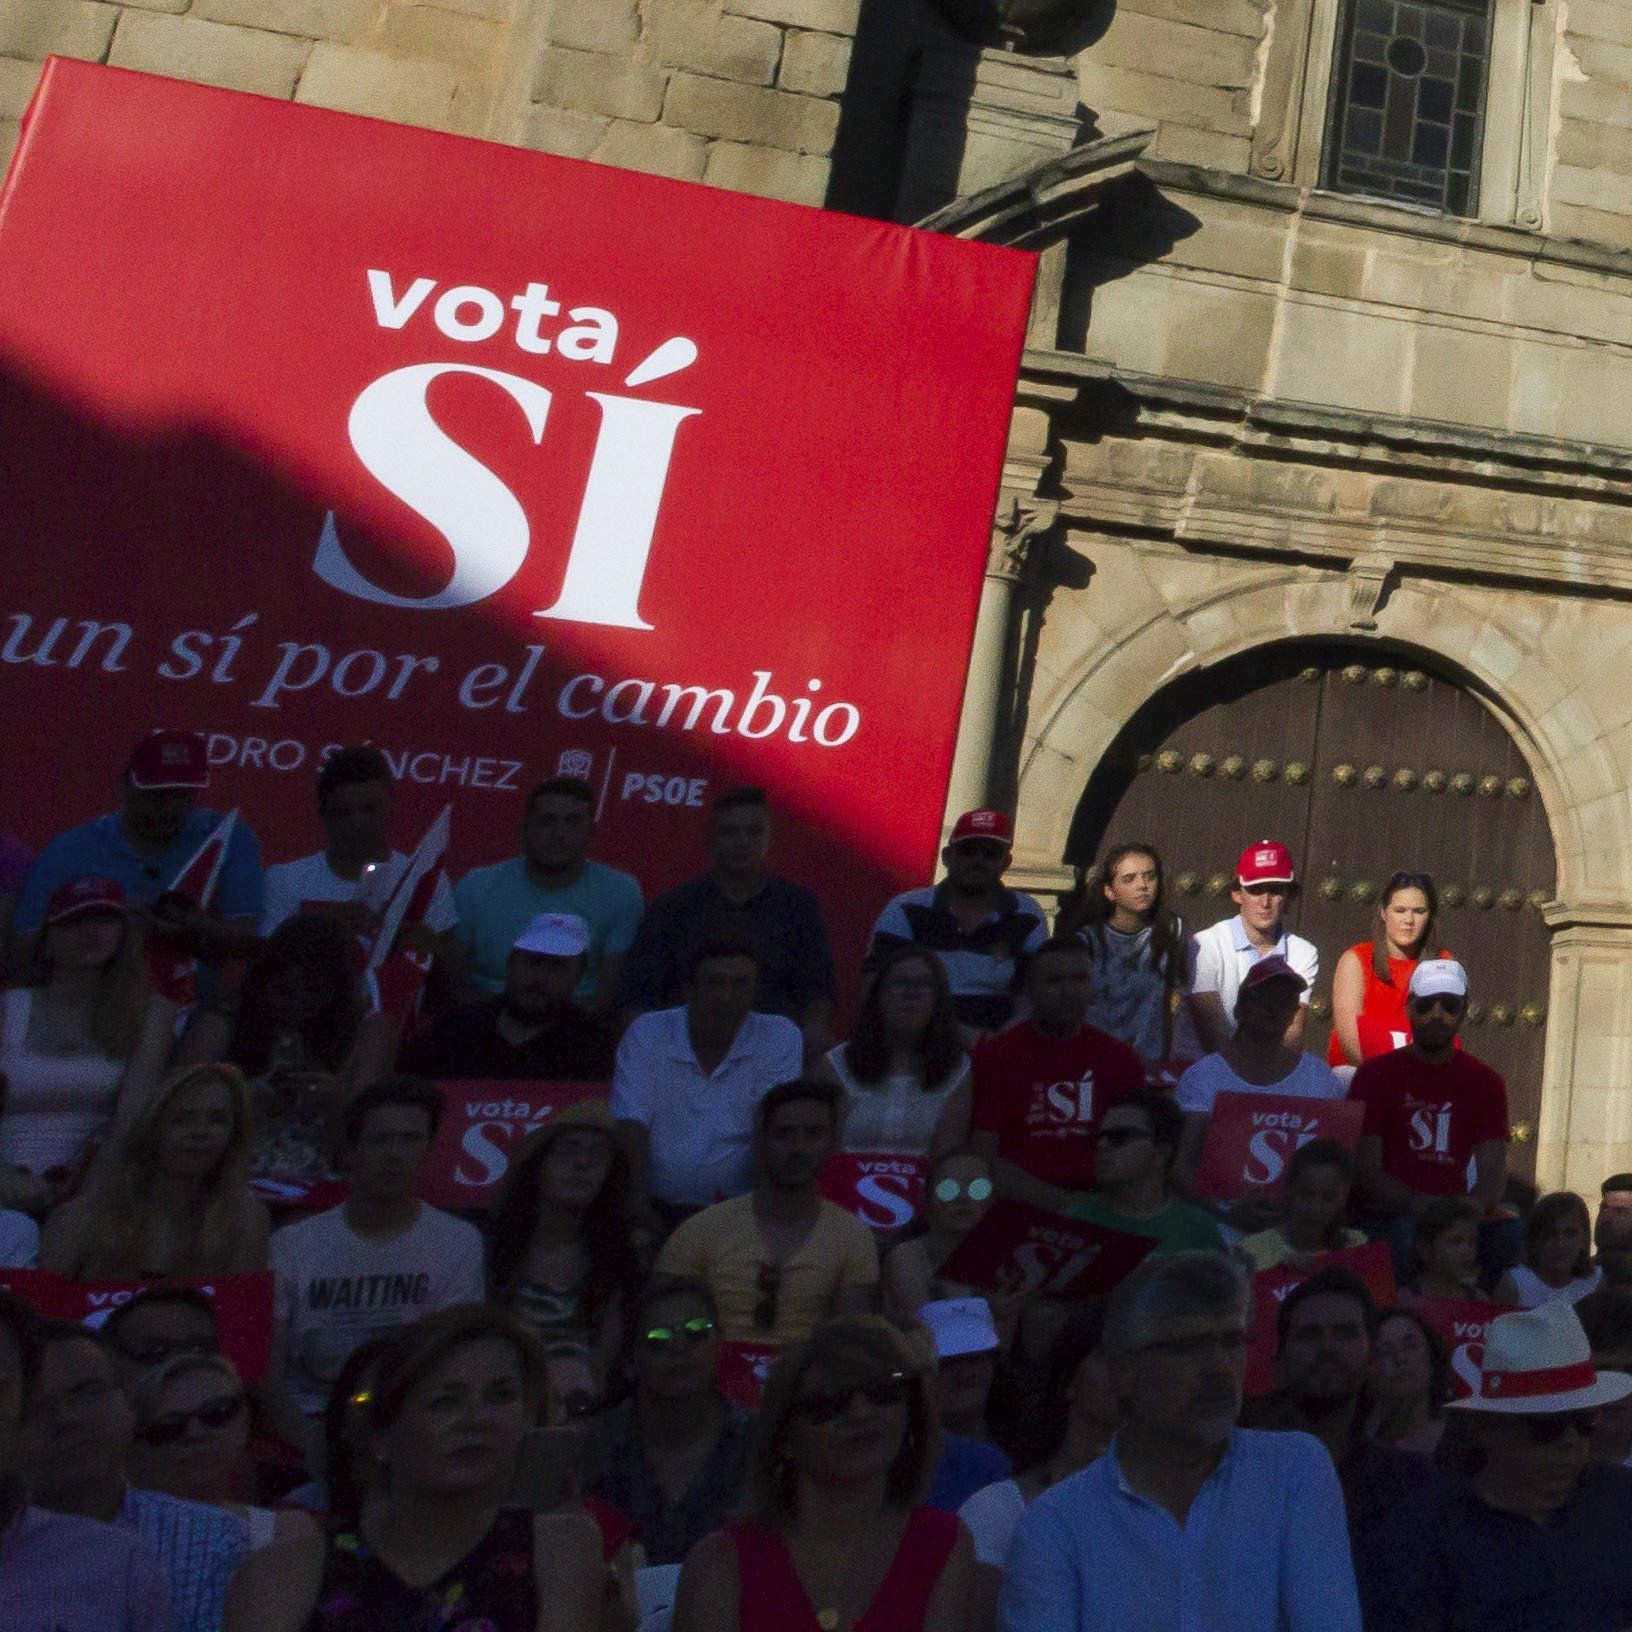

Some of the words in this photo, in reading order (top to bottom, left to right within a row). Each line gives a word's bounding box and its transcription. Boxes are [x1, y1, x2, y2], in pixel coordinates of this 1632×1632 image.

[368, 268, 618, 364] vota
[311, 336, 703, 632] SÍ
[2, 611, 132, 674] un
[157, 612, 259, 684] sí
[250, 643, 438, 709] por
[459, 644, 546, 714] el
[558, 669, 860, 747] cambio
[152, 728, 304, 771] DRO
[621, 771, 708, 808] PSOE
[464, 1099, 531, 1118] vota
[1047, 1069, 1095, 1123] SÍ
[1251, 1113, 1302, 1129] vota
[857, 1159, 917, 1175] vota
